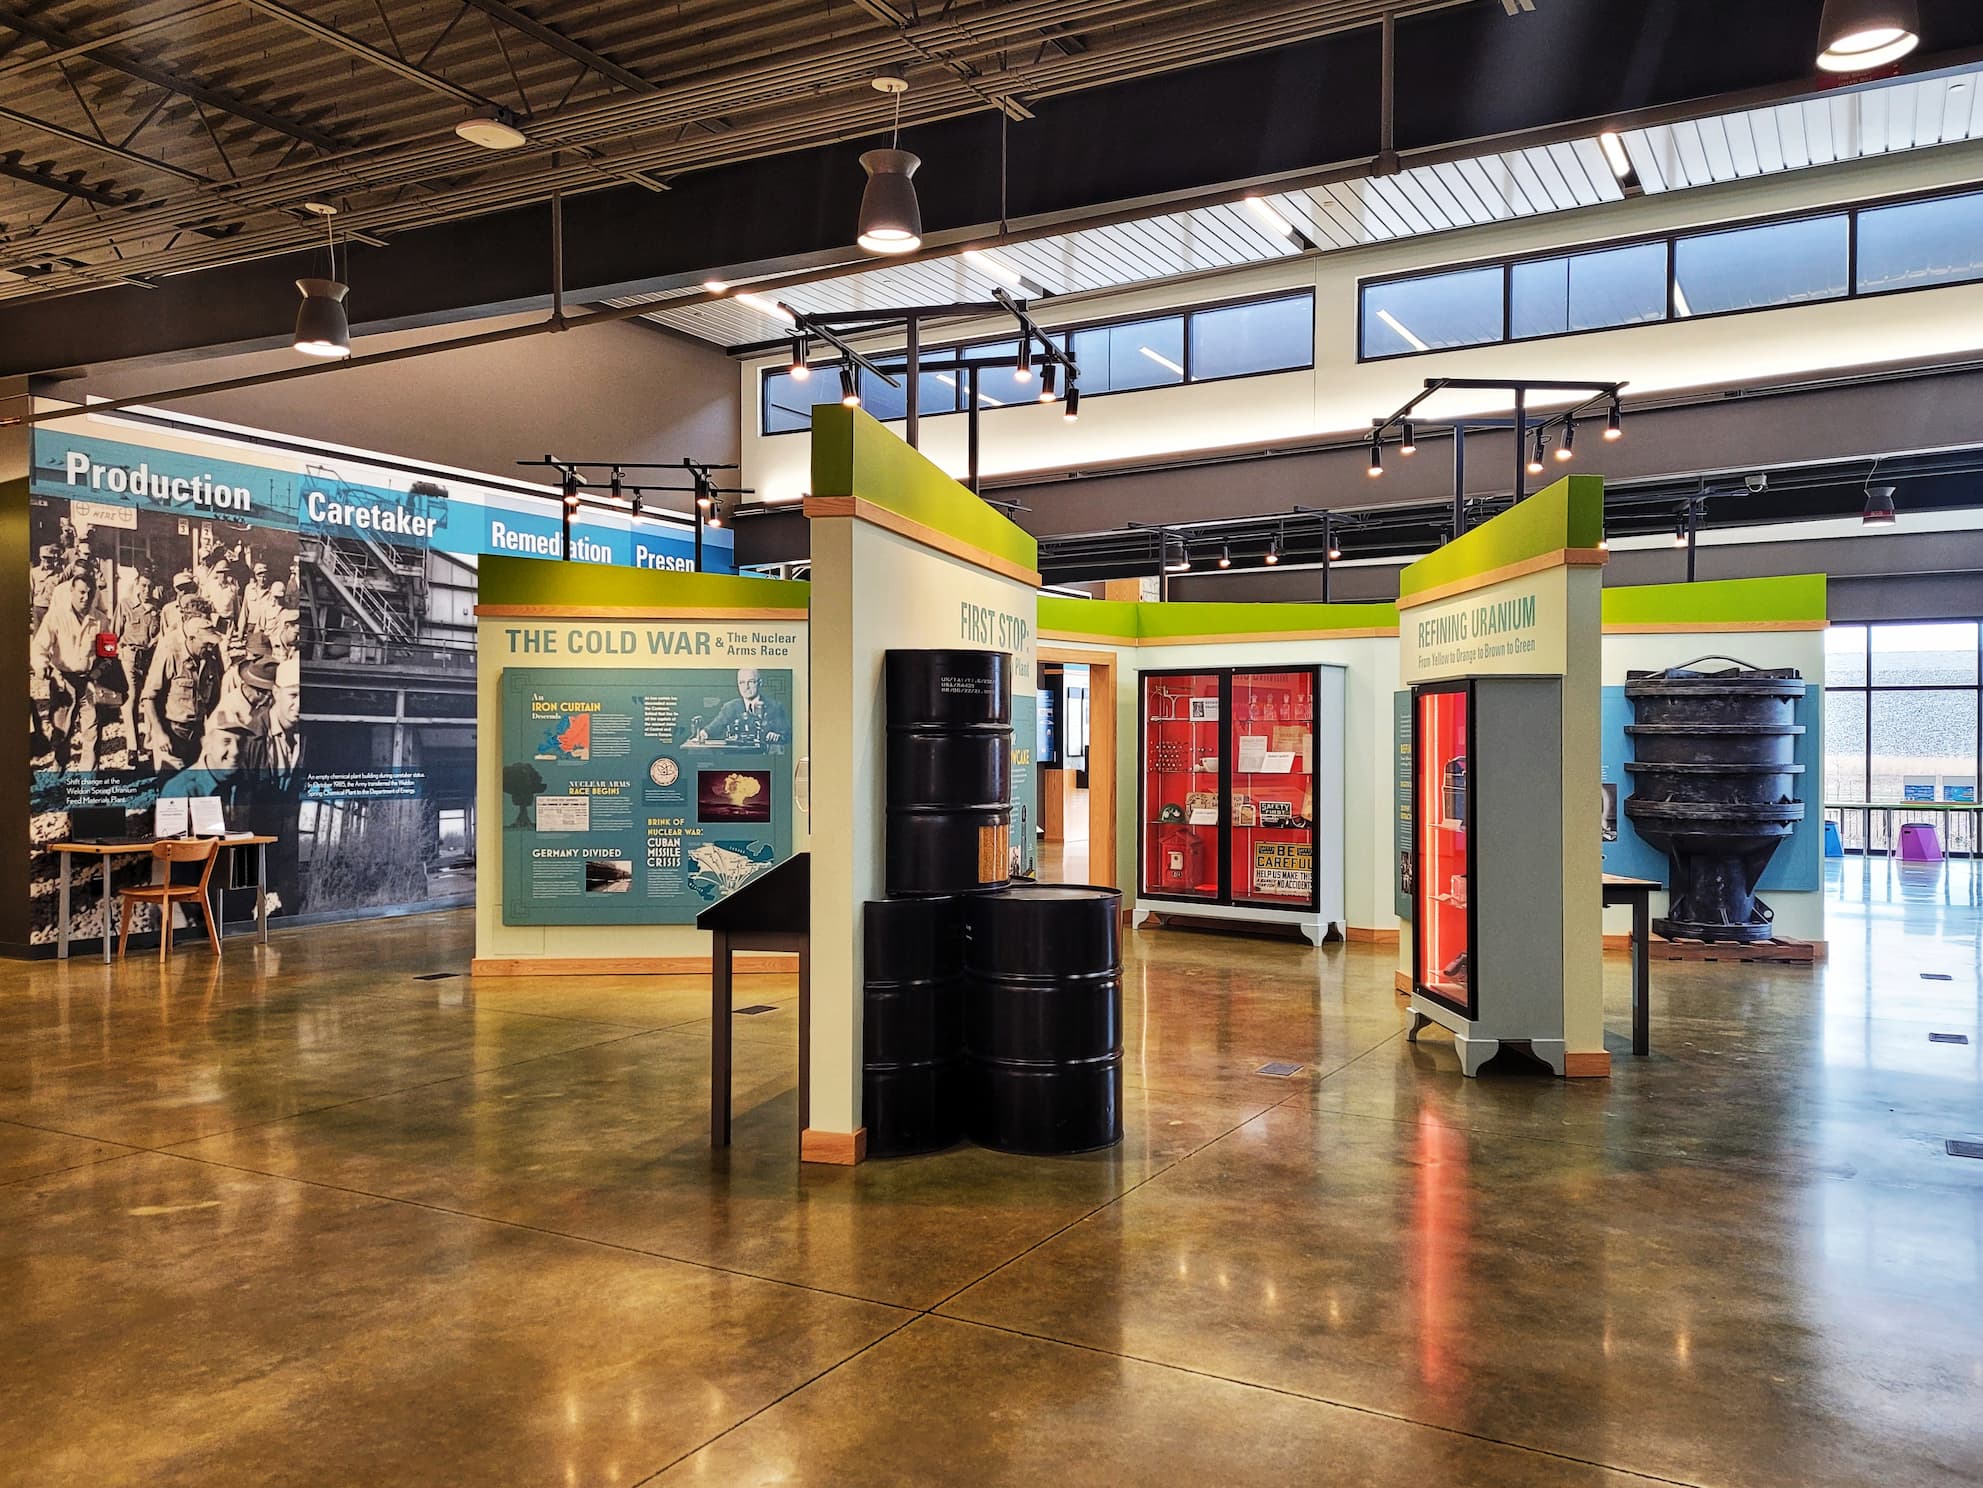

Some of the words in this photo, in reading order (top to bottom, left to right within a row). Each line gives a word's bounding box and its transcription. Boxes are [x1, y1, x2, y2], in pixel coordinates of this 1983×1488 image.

[67, 451, 250, 511] Production
[308, 491, 436, 537] Caretaker
[636, 545, 696, 572] Presen
[961, 601, 995, 645] FIRST
[999, 612, 1029, 653] STOP:
[1418, 611, 1468, 649] REFINING
[1472, 595, 1535, 638] URANIUM
[505, 629, 557, 653] THE
[567, 630, 637, 654] COLD
[647, 631, 710, 655] WAR
[715, 637, 724, 648] &
[727, 632, 748, 643] The
[752, 633, 796, 644] Nuclear
[727, 646, 757, 656] Arms
[760, 646, 788, 656] Race
[1418, 655, 1431, 668] From
[1432, 652, 1449, 667] Yellow
[1450, 651, 1455, 664] to
[1457, 648, 1476, 664] Orange
[1477, 647, 1483, 659] to
[1484, 643, 1505, 658] Brown
[1507, 641, 1513, 655] to
[1515, 638, 1535, 654] Green
[532, 702, 557, 712] IRON
[560, 702, 601, 712] CURTAIN
[308, 772, 315, 780] An
[330, 772, 350, 780] chemical
[350, 772, 361, 780] plant
[362, 772, 378, 780] building
[66, 777, 80, 786] Shift
[81, 777, 103, 786] change
[111, 777, 120, 785] the
[569, 780, 606, 788] NUCLEAR
[66, 787, 90, 795] Weldon
[91, 786, 111, 796] Spring
[112, 786, 138, 794] Uranium
[308, 789, 322, 797] Spring
[345, 788, 356, 796] Plant
[370, 788, 395, 796] Department
[66, 797, 81, 805] Feed
[83, 796, 110, 804] Materials
[1261, 803, 1290, 811] SAFETY
[647, 828, 682, 836] NUCLEAR
[647, 837, 680, 848] CUBAN
[532, 849, 579, 857] GERMANY
[583, 849, 622, 857] DIVIDED
[647, 848, 680, 857] MISSILE
[1278, 846, 1295, 856] BE
[647, 858, 680, 867] CRISIS
[1258, 857, 1312, 869] CAREFUL
[1257, 869, 1271, 878] HELP
[1278, 880, 1285, 888] NO
